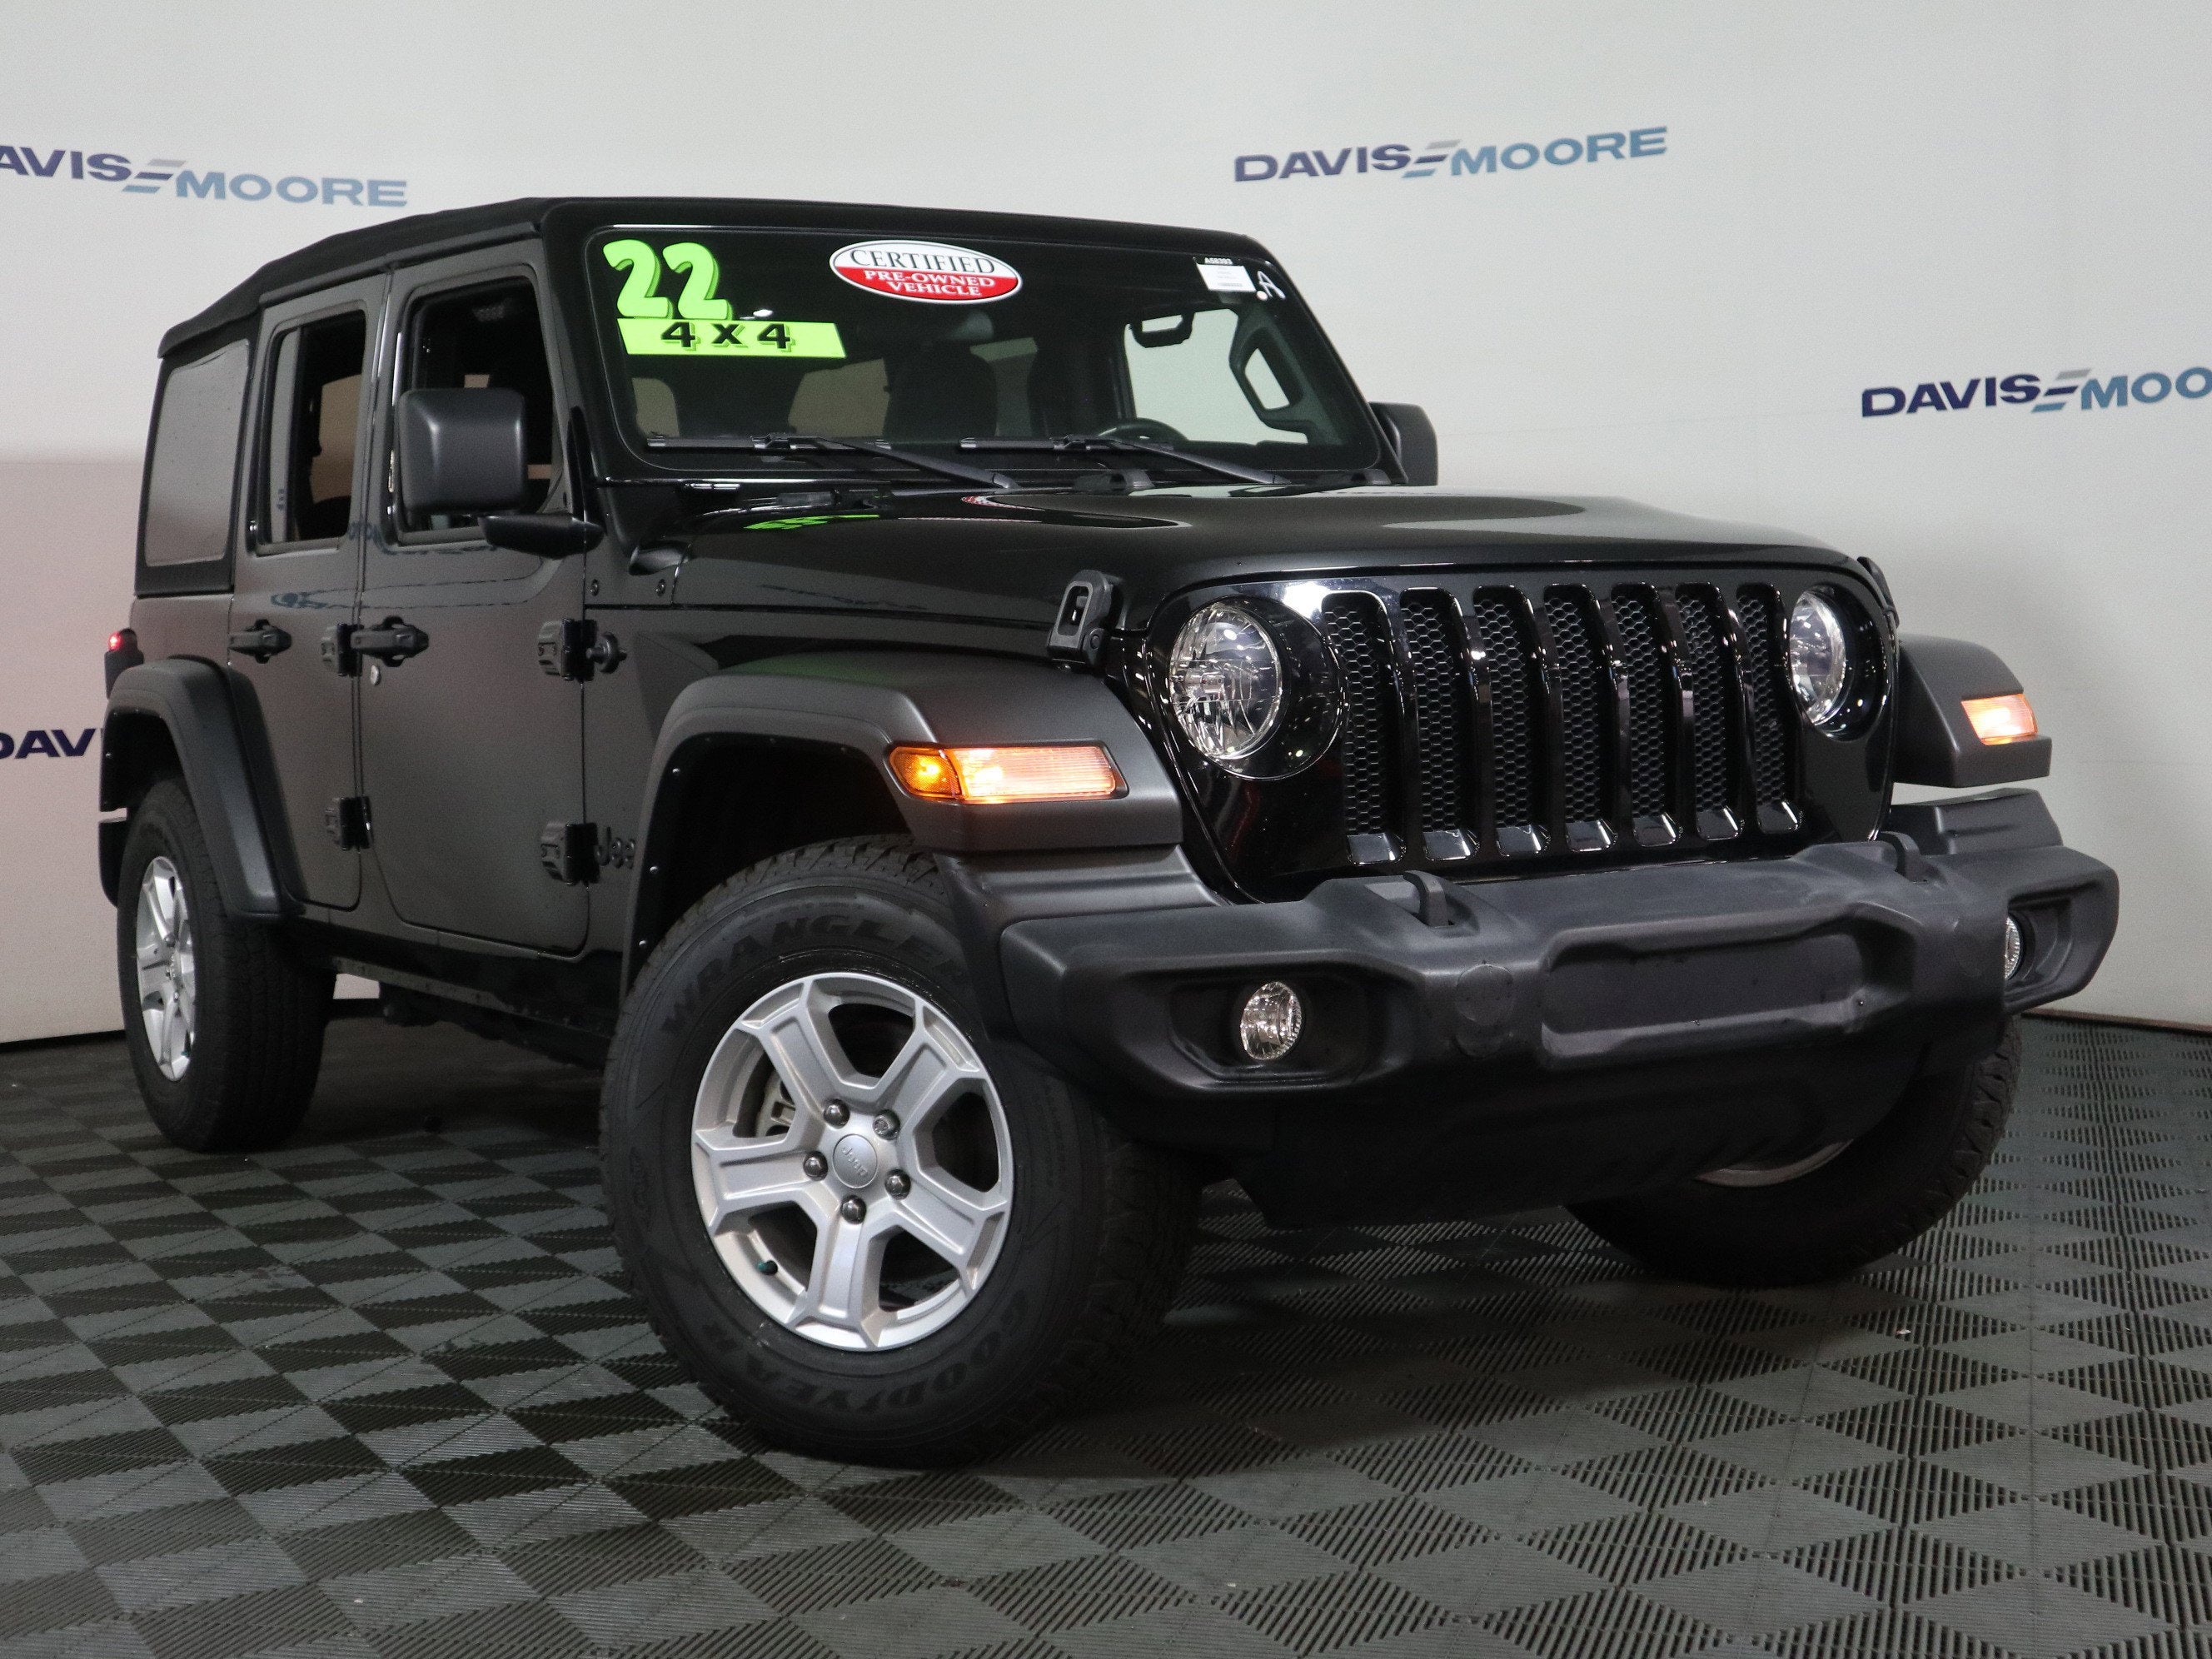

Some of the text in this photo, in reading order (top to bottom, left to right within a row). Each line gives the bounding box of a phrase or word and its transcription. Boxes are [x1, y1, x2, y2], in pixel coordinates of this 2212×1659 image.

[0, 145, 407, 207] AVIS MOORE
[1234, 126, 1667, 182] DAVIS MOORE
[603, 239, 733, 320] 22
[849, 249, 995, 274] CERTIFIED
[863, 270, 995, 286] PRE-OWNED
[886, 281, 982, 296] VEHICLE
[1861, 366, 2212, 417] DAVIS MOO
[594, 826, 637, 869] Jee
